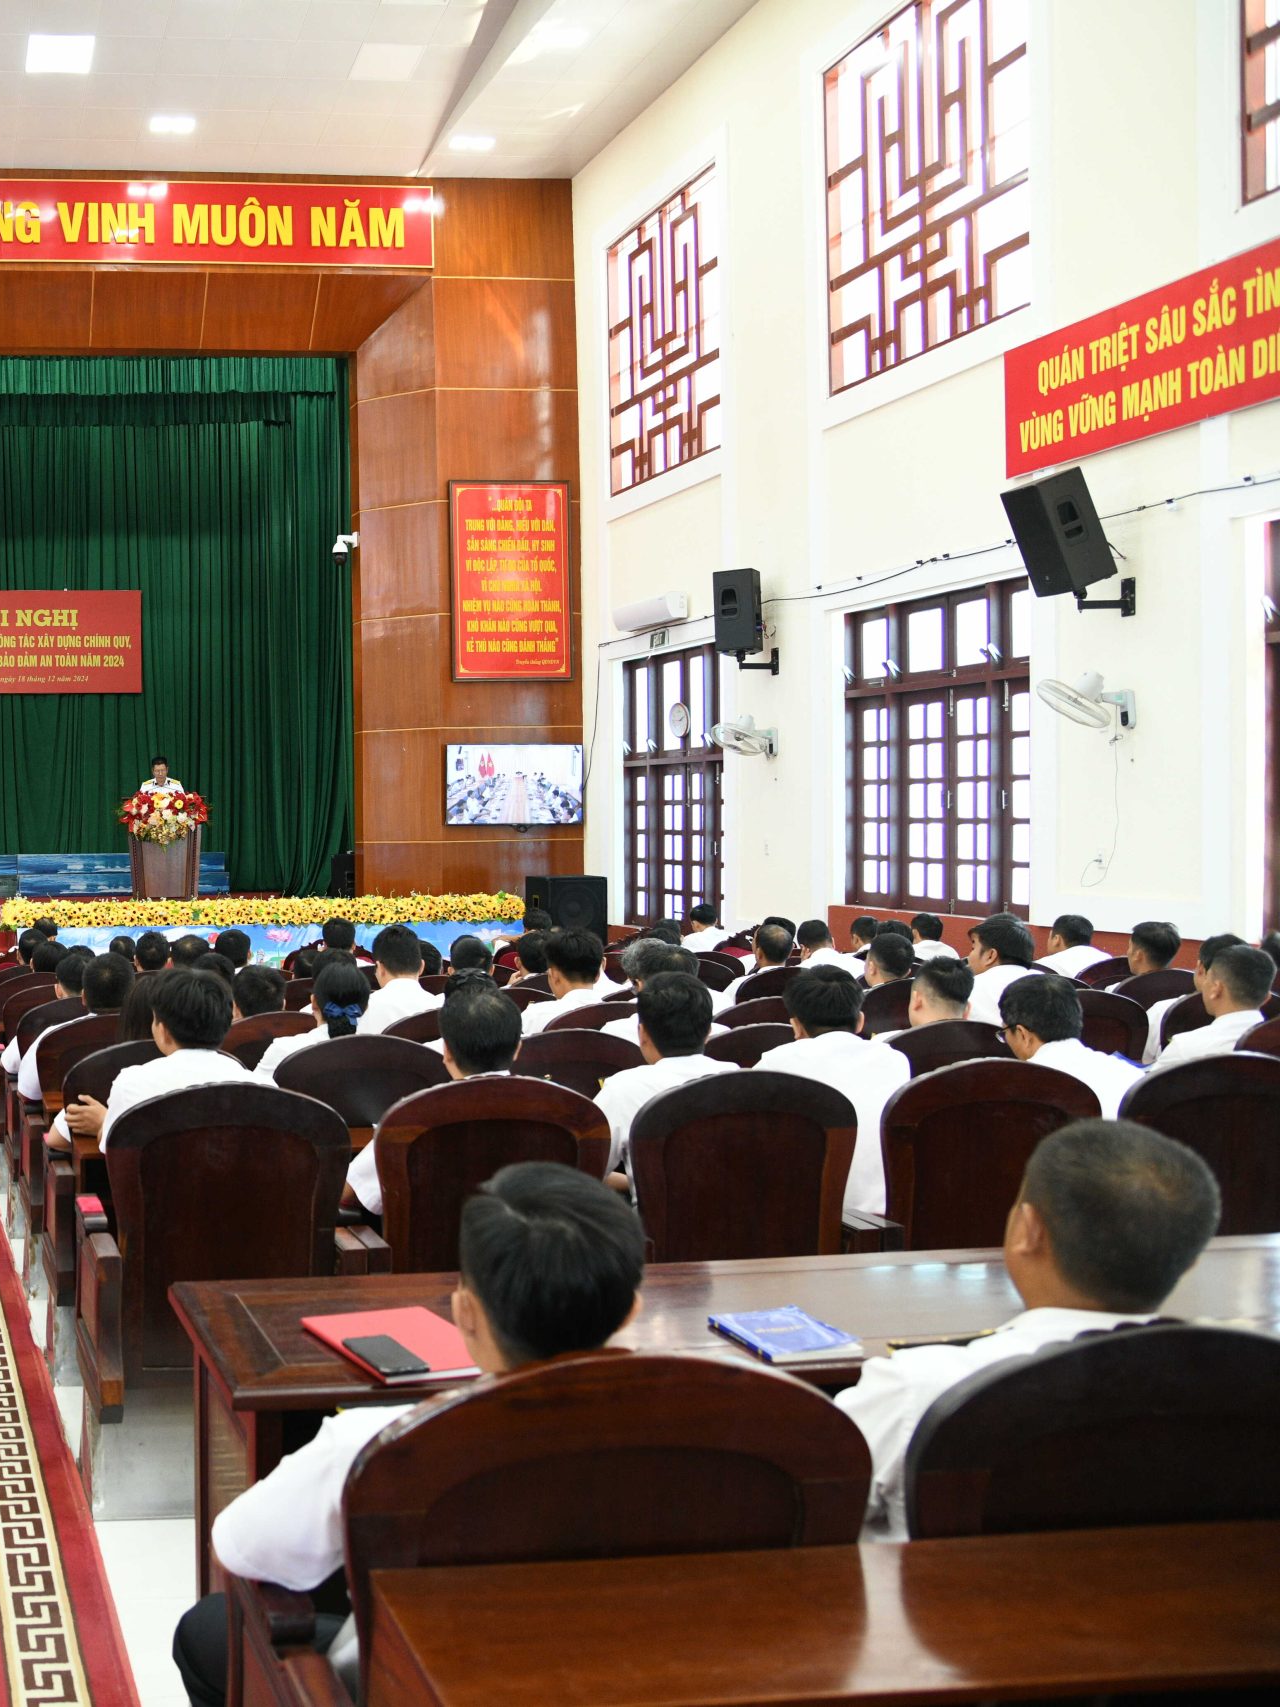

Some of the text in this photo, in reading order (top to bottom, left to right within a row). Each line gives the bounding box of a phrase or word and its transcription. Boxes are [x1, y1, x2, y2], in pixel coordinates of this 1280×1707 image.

[57, 202, 154, 244] VINH
[173, 197, 294, 247] MUÔN
[310, 198, 405, 248] NĂM
[1038, 344, 1084, 396] QUÁN
[1089, 322, 1140, 372] TRIỆT
[1145, 304, 1186, 354] SÂU
[1192, 278, 1236, 337] SẮC
[1020, 411, 1063, 453] VÙNG
[1068, 393, 1116, 438] VỮNG
[1122, 368, 1182, 422] MẠNH
[1187, 345, 1245, 399] TOÀN
[465, 519, 484, 531] TRUNG
[486, 517, 496, 531] VỚI
[531, 517, 540, 531] VỚI
[541, 540, 555, 551] SINH
[16, 610, 78, 630] NGHỊ
[18, 633, 35, 648] TÁC
[38, 633, 54, 648] XÂY
[57, 635, 81, 650] DỰNG
[84, 633, 111, 647] CHÍNH
[113, 636, 131, 649] QUY,
[18, 651, 37, 667] ĐẢM
[40, 656, 52, 667] AN
[56, 652, 78, 667] TOÀN
[80, 652, 100, 667] NĂM
[103, 656, 124, 667] 2024
[0, 676, 16, 684] ngày
[27, 675, 46, 684] tháng
